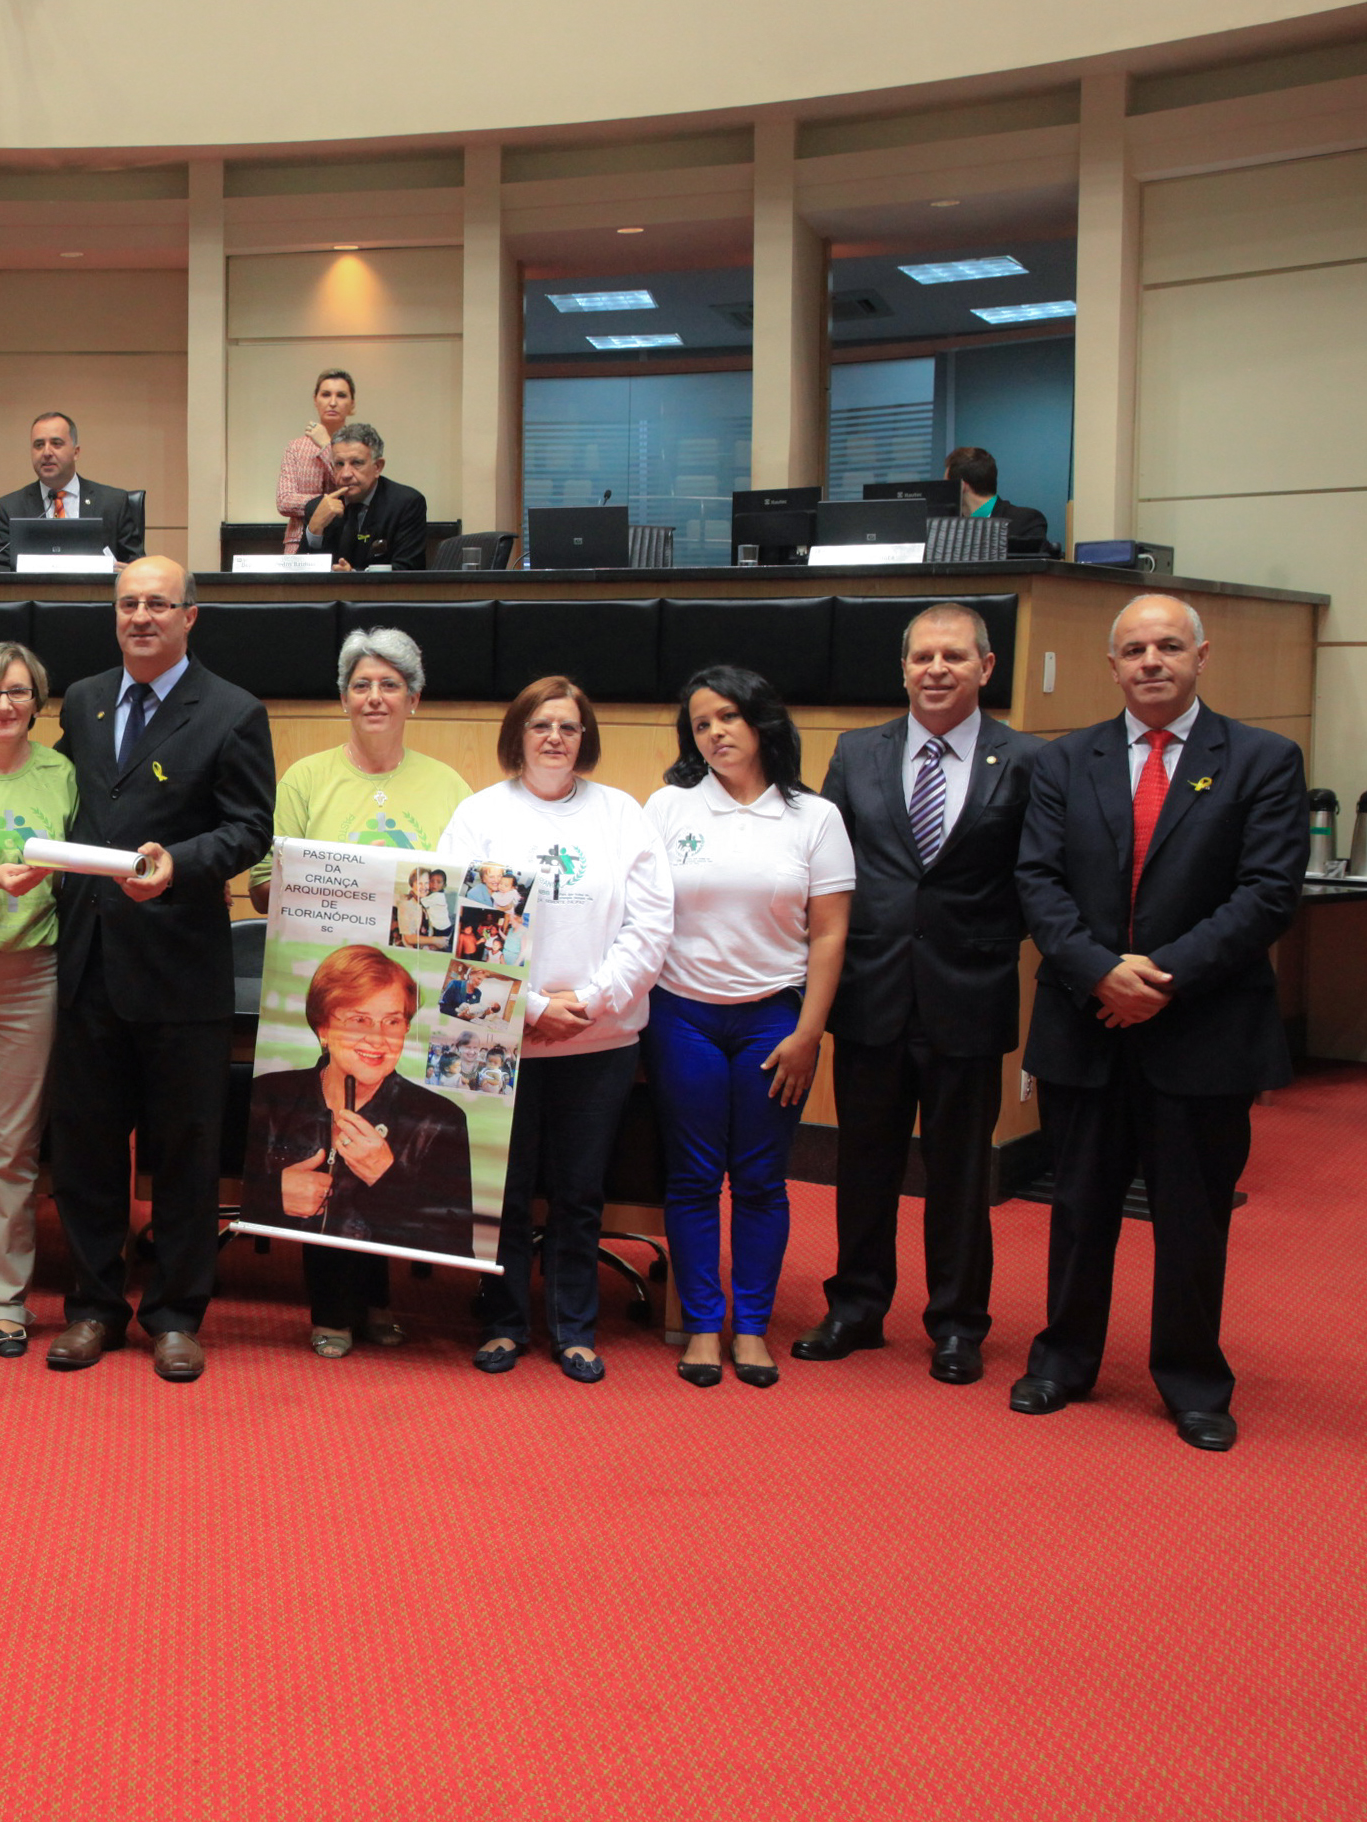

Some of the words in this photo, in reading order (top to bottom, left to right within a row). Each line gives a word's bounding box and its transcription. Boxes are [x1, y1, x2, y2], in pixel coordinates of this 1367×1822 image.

[303, 849, 365, 865] PASTORAL
[325, 864, 341, 873] DA
[305, 874, 359, 888] CRIANÇA
[284, 884, 376, 902] ARQUIDIOCESE
[321, 900, 338, 909] DE
[281, 906, 376, 926] FLORIANÓPOLIS
